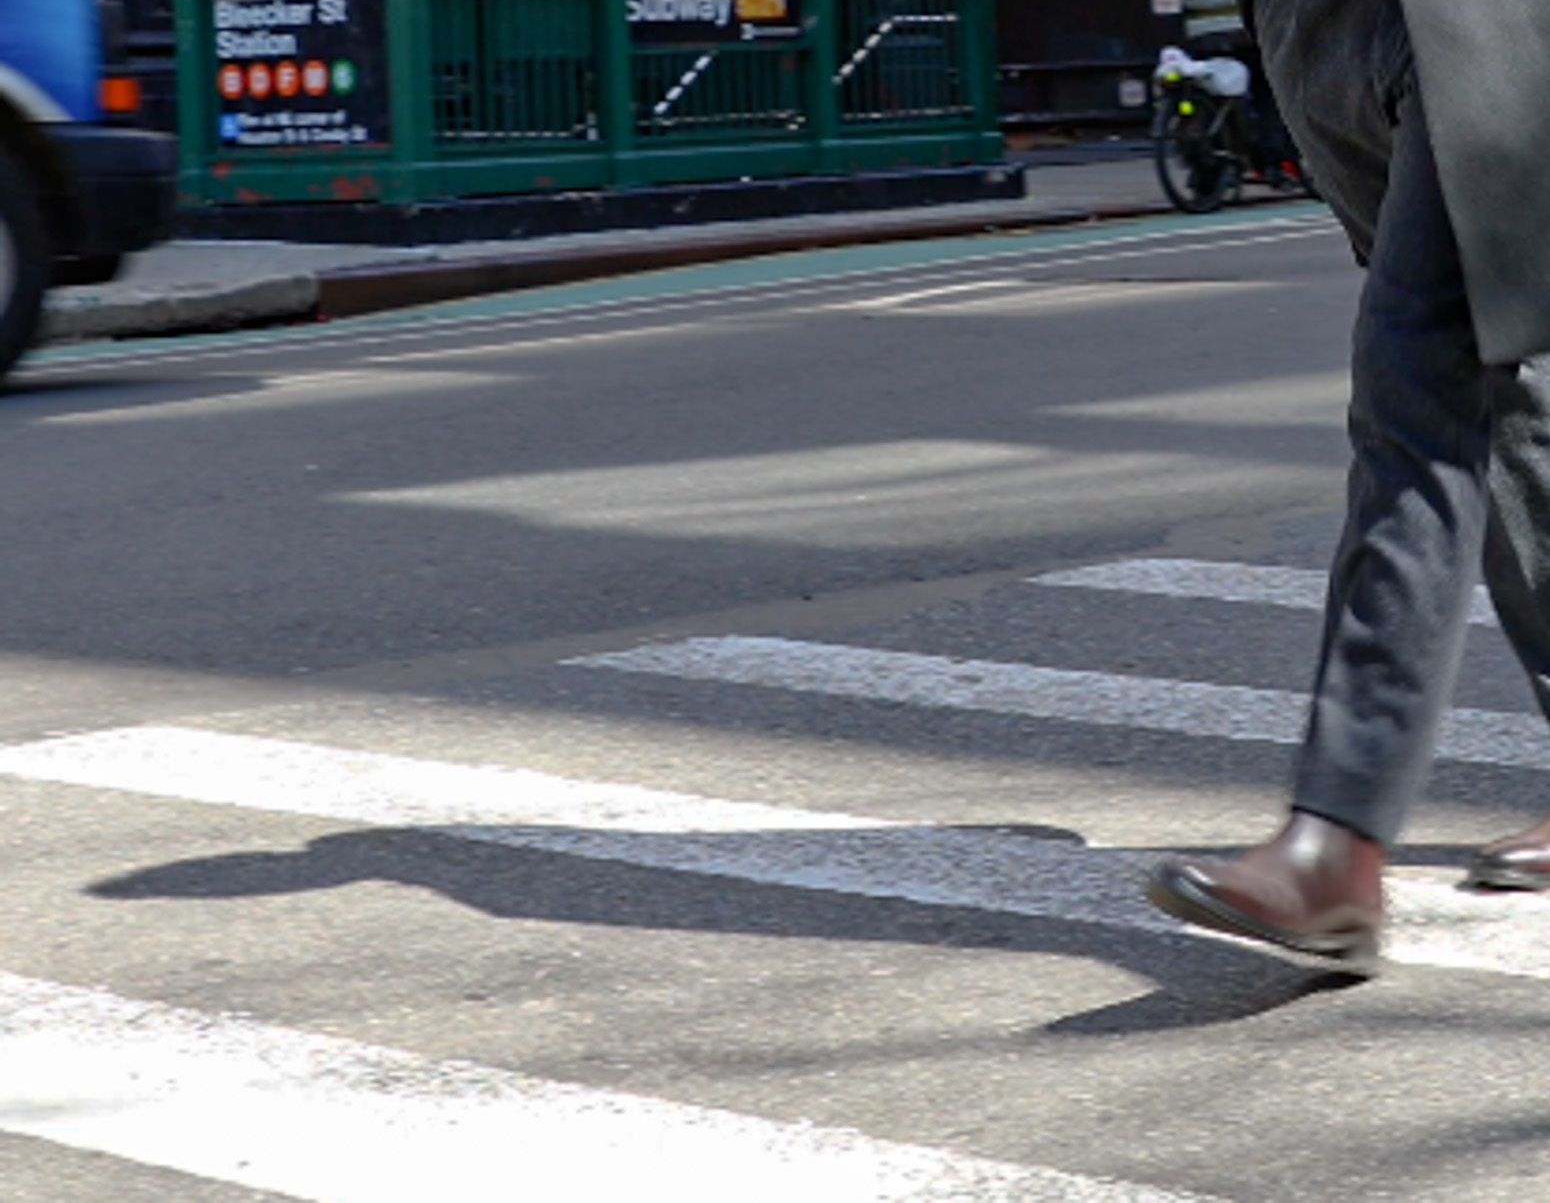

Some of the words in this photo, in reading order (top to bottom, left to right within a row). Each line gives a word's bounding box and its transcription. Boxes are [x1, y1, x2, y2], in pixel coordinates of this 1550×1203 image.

[215, 0, 313, 27] Bleecker
[216, 30, 297, 58] Station
[278, 67, 297, 89] F
